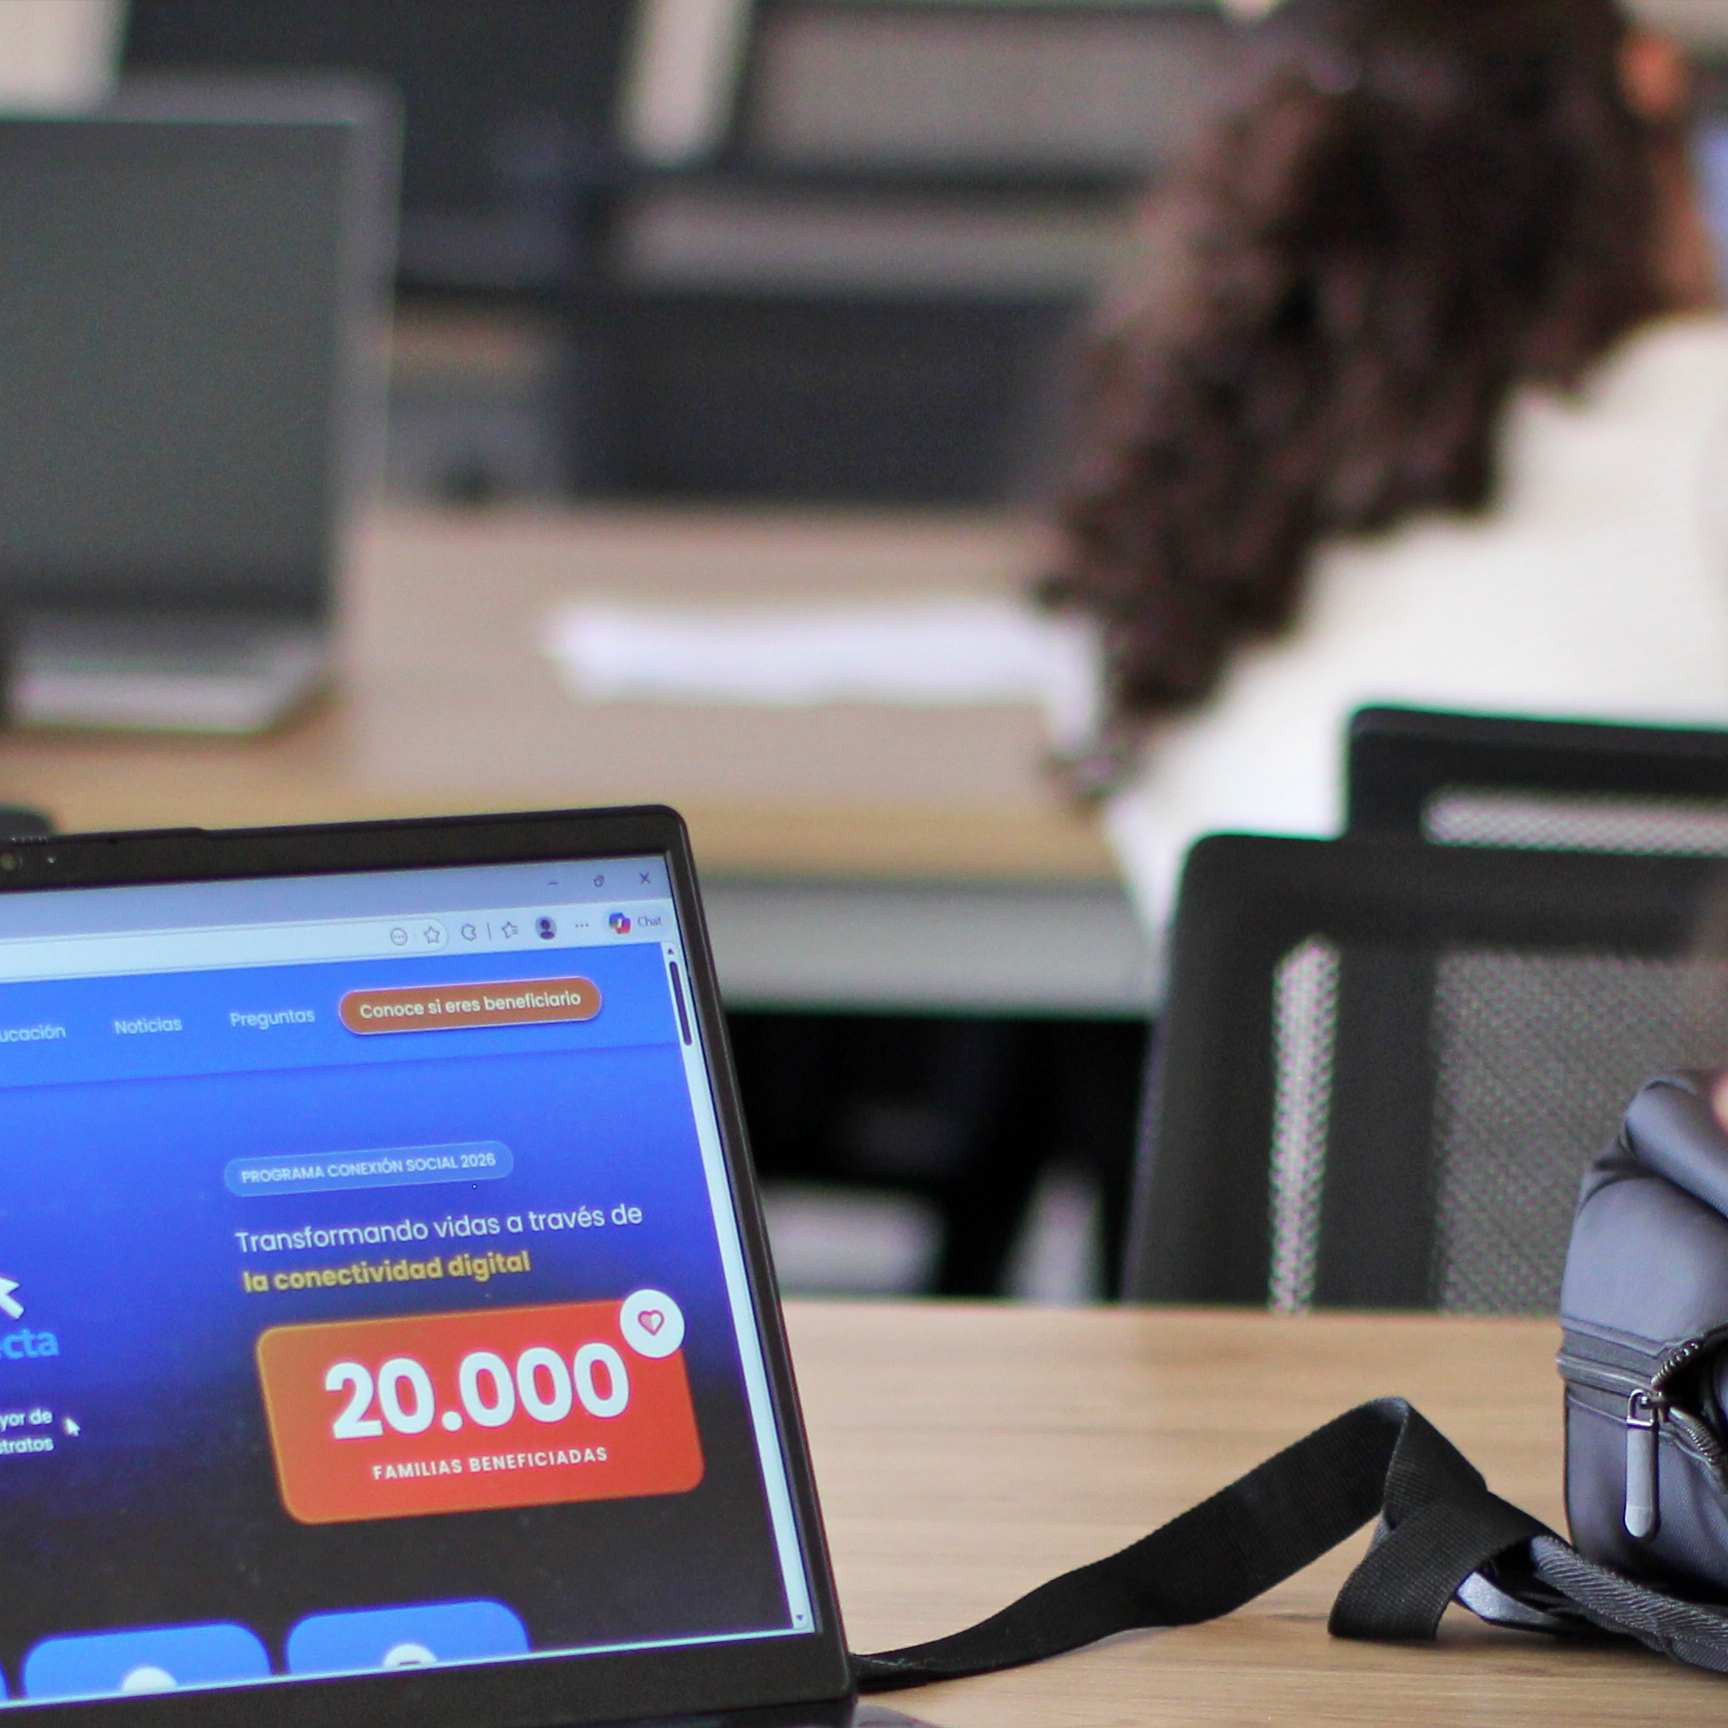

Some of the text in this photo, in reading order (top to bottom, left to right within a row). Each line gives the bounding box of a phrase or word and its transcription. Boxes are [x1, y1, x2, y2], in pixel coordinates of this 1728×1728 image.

[637, 915, 662, 928] Chat
[230, 1007, 316, 1031] Preguntas
[359, 989, 582, 1020] Conoce si eres beneficiario
[114, 1016, 183, 1036] Noticias
[241, 1151, 497, 1185] PROGRAMA CONEXIÓN SOCIAL 2026
[234, 1203, 643, 1254] Transformando vidas a través de
[243, 1250, 532, 1295] la conectividad digital
[324, 1342, 630, 1440] 20.000
[29, 1407, 53, 1425] de
[372, 1446, 609, 1481] FAMILIAS BENEFICIADAS
